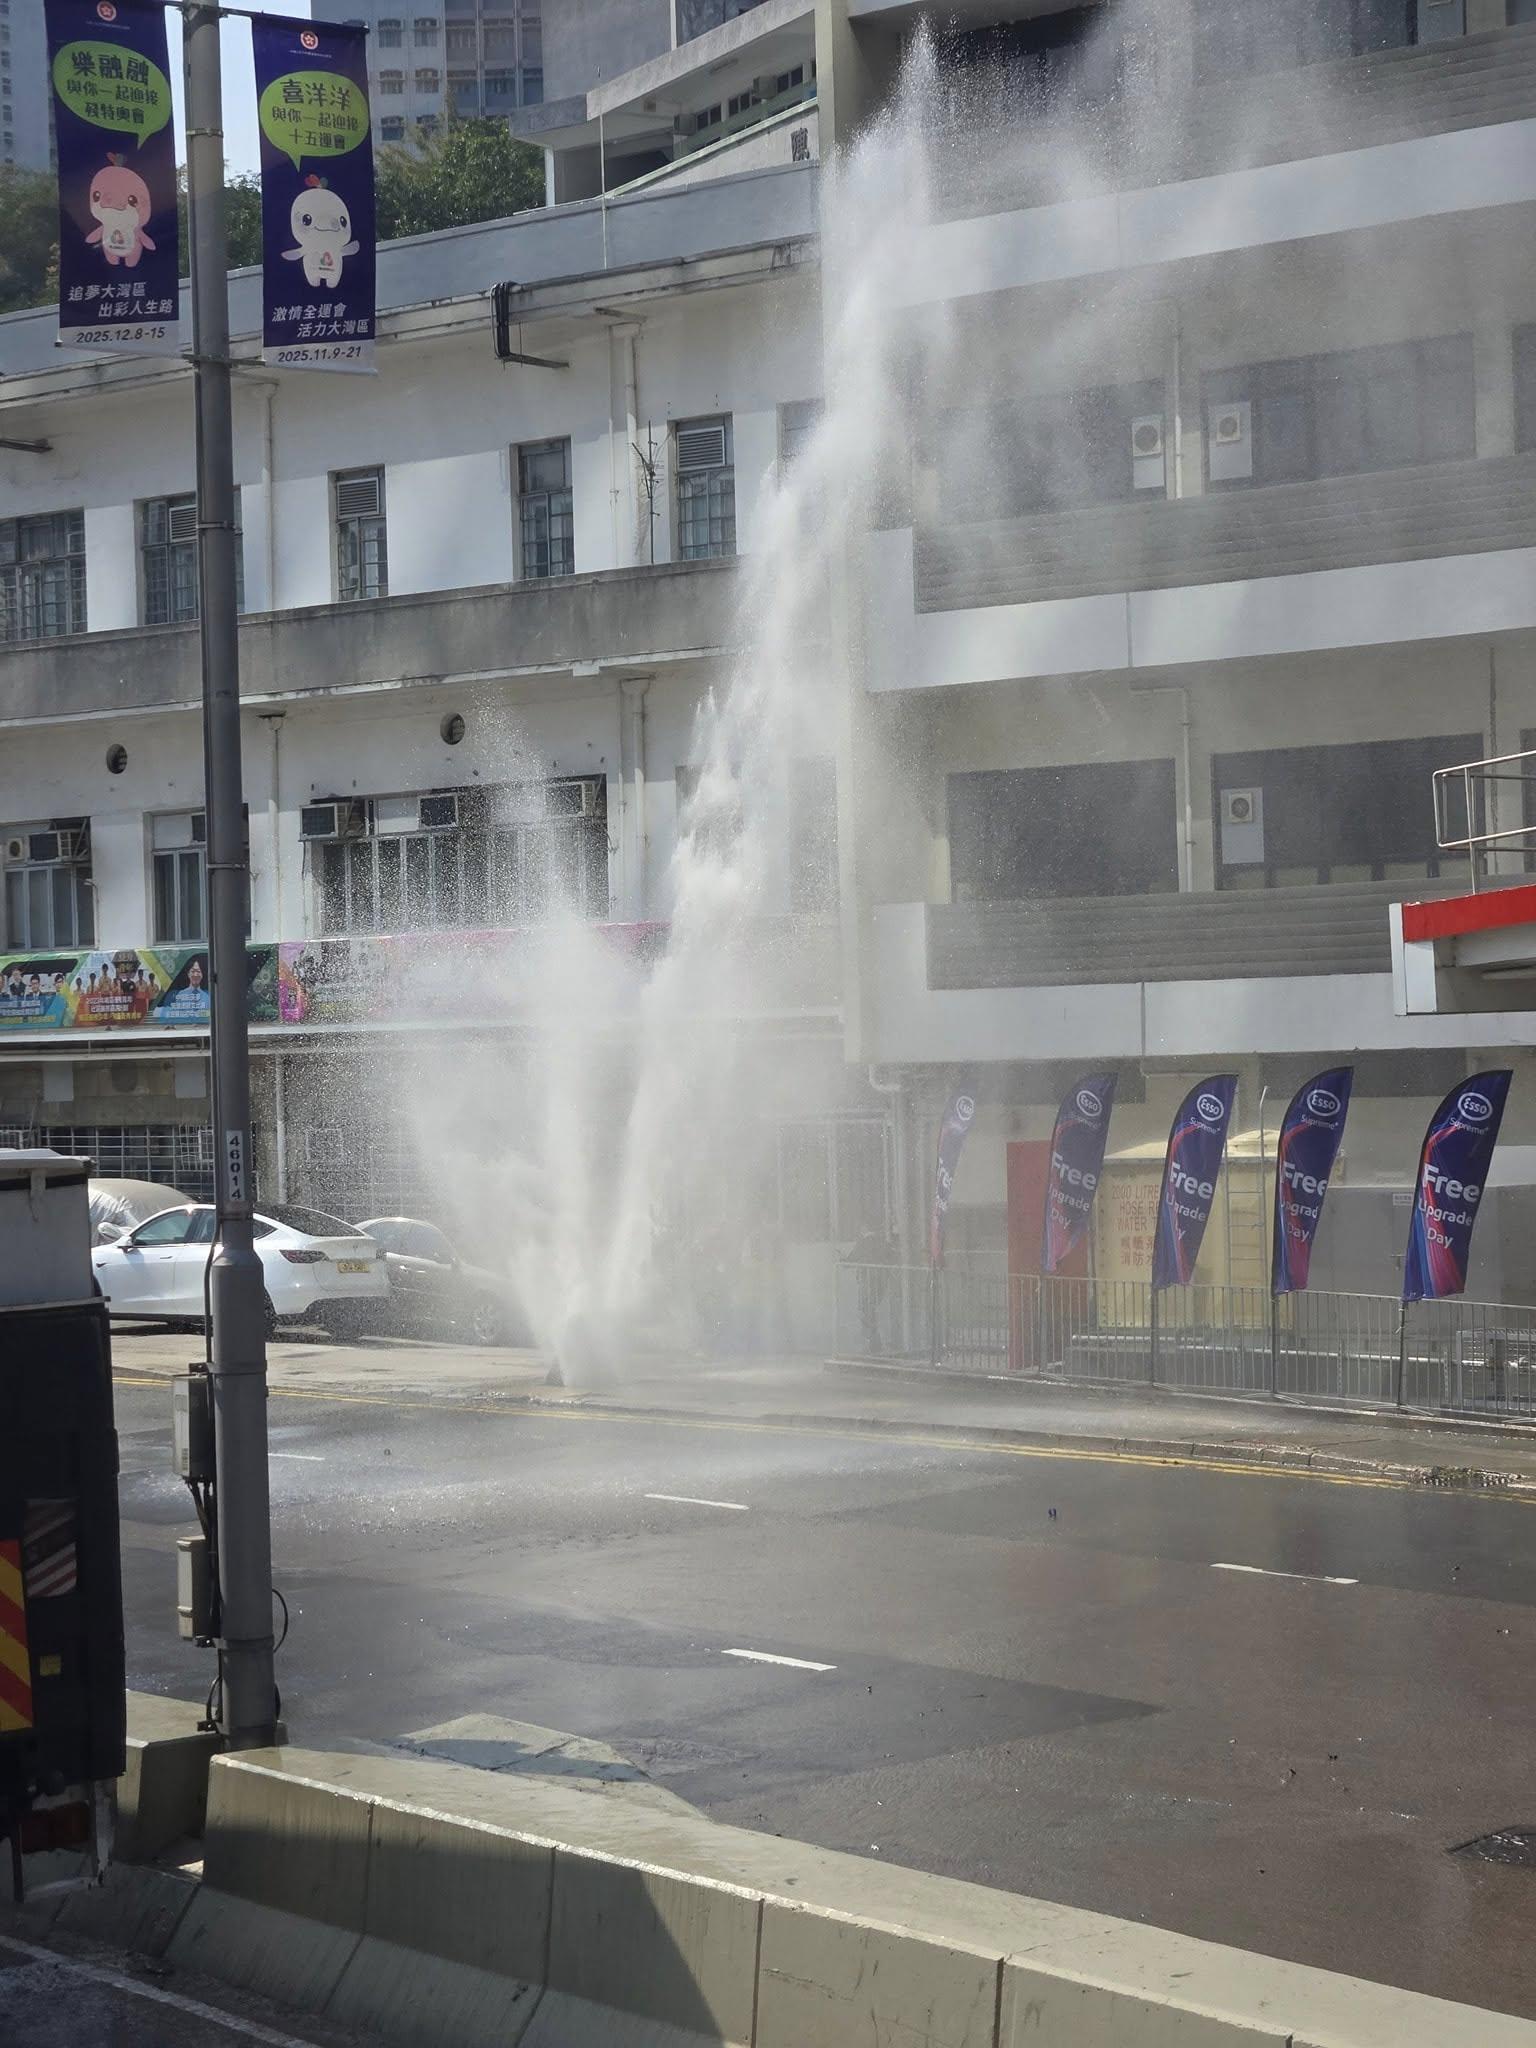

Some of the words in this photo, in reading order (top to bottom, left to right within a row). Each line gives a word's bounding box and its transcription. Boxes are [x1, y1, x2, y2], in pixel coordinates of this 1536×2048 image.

[71, 51, 149, 85] 樂融融
[67, 80, 159, 106] 與你一起迎接
[280, 79, 350, 111] 喜洋洋
[272, 106, 358, 131] 與你一起迎接
[289, 128, 345, 150] 十五運會
[68, 282, 146, 301] 追夢大灣區
[98, 299, 173, 317] 出彩人生路
[272, 303, 347, 322] 激情全運會
[76, 327, 166, 343] 2025.12.8-15
[297, 319, 369, 338] 活力大灣區
[278, 346, 362, 362] 2025.11.9-21
[229, 1135, 242, 1201] 46014
[1051, 1151, 1097, 1191] Free
[1169, 1161, 1213, 1199] Free
[1422, 1163, 1480, 1202] Free
[1050, 1207, 1071, 1230] Day
[1120, 1200, 1144, 1216] HOSE
[1418, 1197, 1472, 1227] Upgrade
[1427, 1227, 1453, 1248] Day
